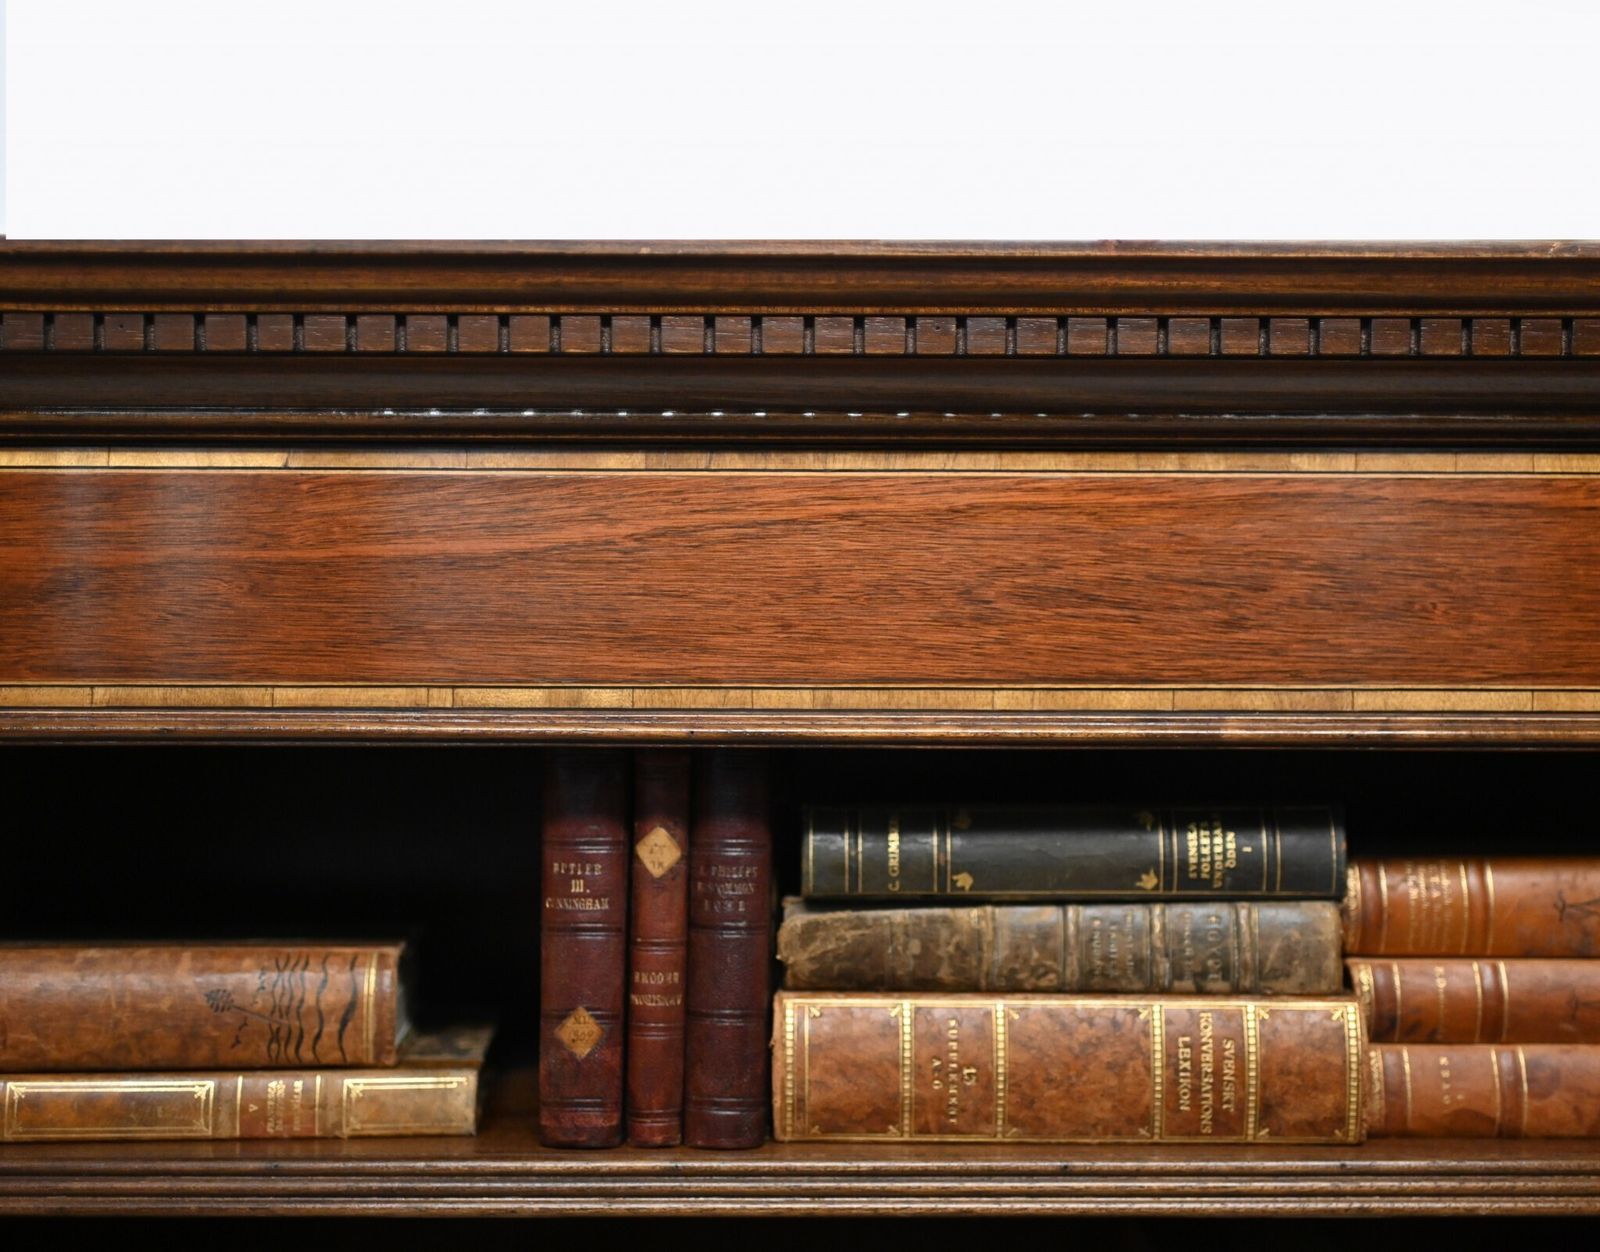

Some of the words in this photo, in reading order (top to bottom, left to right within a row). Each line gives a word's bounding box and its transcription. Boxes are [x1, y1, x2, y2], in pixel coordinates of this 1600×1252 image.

[888, 818, 900, 877] GRIMB
[545, 897, 609, 911] CNNINGHAM
[1178, 1037, 1191, 1112] LEXIKON
[1200, 1012, 1213, 1135] KONVERSATIONS
[1222, 1039, 1235, 1113] SVENSKT
